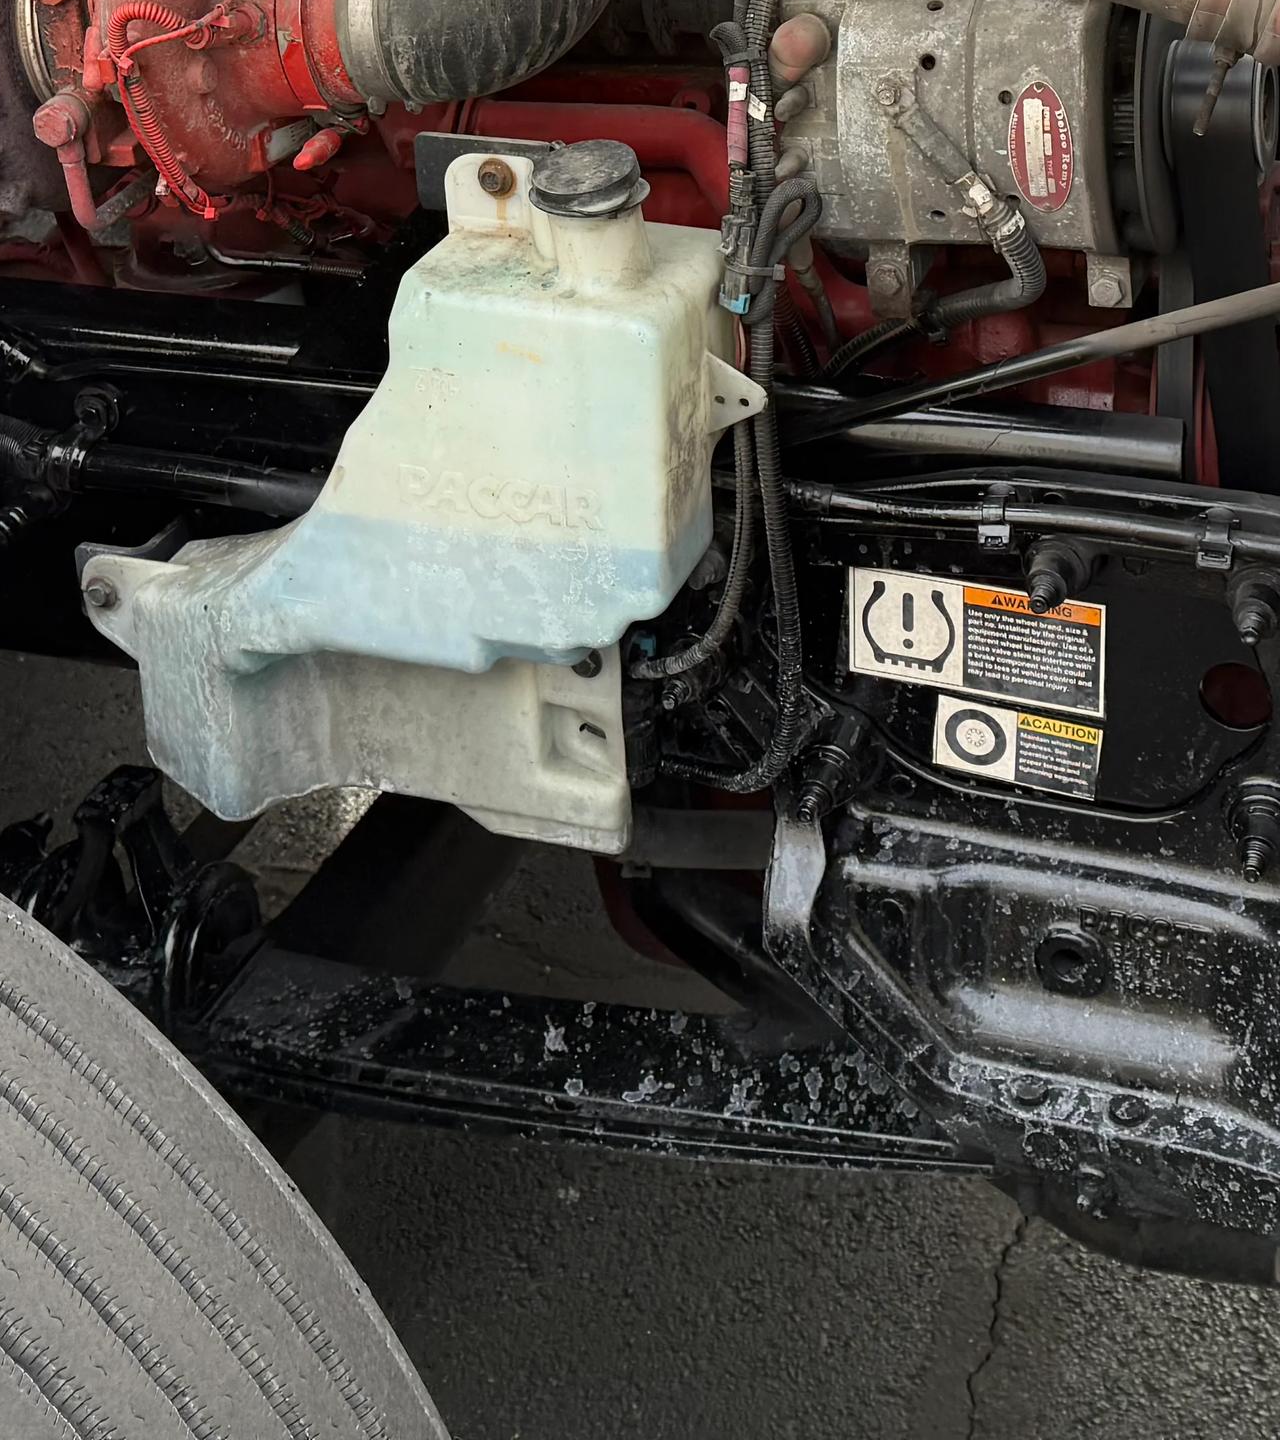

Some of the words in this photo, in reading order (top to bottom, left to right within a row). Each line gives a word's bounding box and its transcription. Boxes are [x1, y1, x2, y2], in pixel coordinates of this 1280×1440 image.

[1054, 109, 1068, 149] Delco
[1059, 153, 1070, 189] Remy
[399, 463, 605, 530] PACCAR
[1004, 596, 1073, 618] WAING
[968, 609, 982, 617] Use
[984, 612, 1001, 622] only
[1002, 615, 1014, 623] the
[1016, 617, 1038, 627] wheel
[1066, 626, 1081, 635] size
[968, 627, 1008, 639] equipment
[1063, 644, 1078, 652] Use
[1031, 629, 1041, 637] by
[1042, 631, 1055, 639] the
[1057, 633, 1086, 644] original
[992, 647, 1011, 656] valve
[1013, 650, 1032, 660] stem
[1033, 653, 1041, 661] to
[1075, 661, 1092, 671] with
[1000, 641, 1022, 650] wheel
[1024, 645, 1046, 655] brand
[1058, 650, 1073, 659] size
[1074, 654, 1096, 663] could
[968, 659, 983, 668] lead
[985, 661, 993, 669] to
[1021, 669, 1048, 680] vehicle
[1049, 674, 1077, 685] control
[1077, 679, 1093, 688] and
[974, 652, 995, 662] brake
[996, 657, 1039, 670] component
[1040, 663, 1063, 674] which
[1064, 668, 1086, 678] could
[968, 667, 983, 677] may
[985, 670, 1001, 679] lead
[1002, 673, 1010, 681] to
[1011, 676, 1045, 689] personal
[1032, 718, 1097, 741] CAUTION
